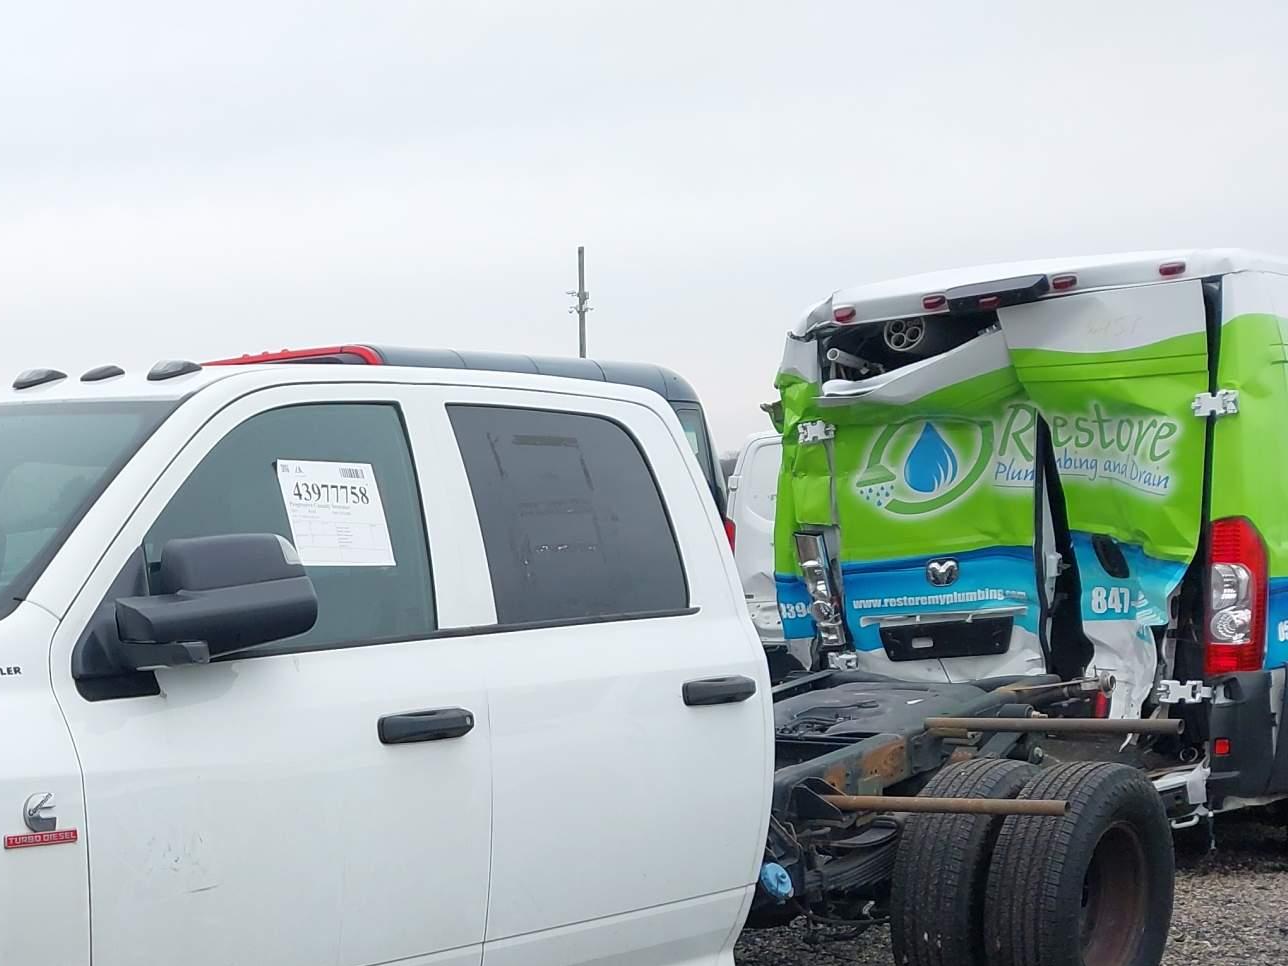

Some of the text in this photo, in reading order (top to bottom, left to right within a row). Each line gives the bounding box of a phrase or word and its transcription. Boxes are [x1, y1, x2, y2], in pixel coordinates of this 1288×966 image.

[998, 403, 1177, 462] Restore
[1104, 455, 1127, 478] and
[1130, 460, 1170, 489] Drain
[293, 481, 369, 504] 43977758
[852, 588, 1027, 609] www.restoremyplumbing
[8, 831, 77, 845] TURBO DIESEL
